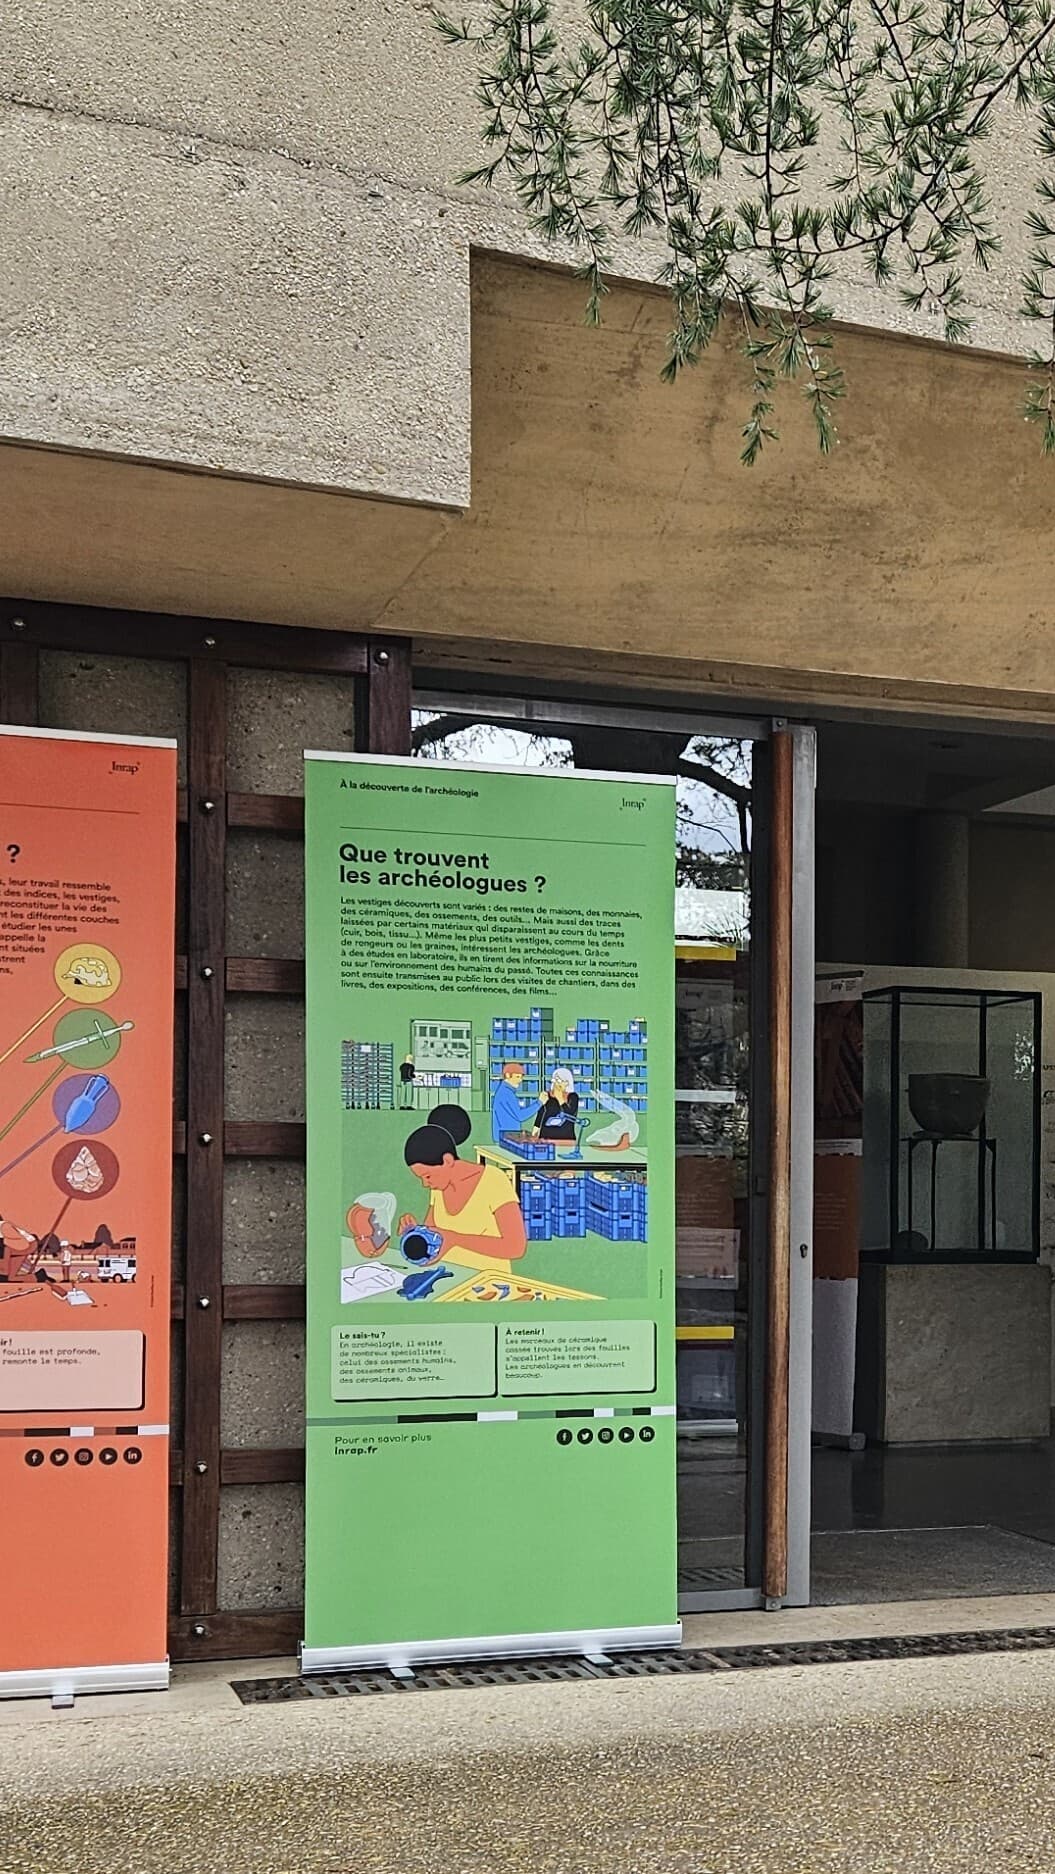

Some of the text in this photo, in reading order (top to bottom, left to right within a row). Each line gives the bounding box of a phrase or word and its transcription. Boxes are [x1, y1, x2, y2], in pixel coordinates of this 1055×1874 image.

[112, 761, 139, 774] Inrap
[340, 778, 479, 799] À la découverte de l'archéologie
[622, 798, 644, 810] Inrap
[7, 844, 20, 863] ?
[339, 842, 489, 868] Que trouvent
[8, 877, 28, 887] leur
[30, 878, 59, 888] travail
[62, 882, 111, 891] ressemble
[340, 864, 546, 894] les archéologues ?
[3, 888, 21, 897] des
[63, 891, 76, 900] les
[61, 902, 70, 911] la
[73, 903, 87, 912] vie
[90, 903, 107, 913] des
[341, 896, 356, 905] Les
[357, 898, 392, 908] vestiges
[394, 899, 440, 909] découverts
[443, 902, 461, 910] sont
[462, 903, 486, 911] variés
[493, 904, 508, 912] des
[510, 905, 534, 913] restes
[536, 906, 547, 914] de
[586, 908, 600, 916] des
[10, 910, 24, 919] les
[26, 911, 78, 922] différentes
[80, 915, 119, 924] couches
[1, 920, 36, 931] étudier
[38, 922, 52, 932] les
[340, 917, 375, 927] laissées
[377, 921, 392, 929] par
[394, 920, 429, 929] certains
[431, 922, 474, 931] matériaux
[475, 924, 489, 934] qui
[491, 924, 546, 935] disparaissent
[587, 928, 597, 937] du
[599, 929, 625, 940] temps
[37, 933, 46, 942] la
[11, 943, 45, 953] situées
[57, 1348, 100, 1356] profonde,
[54, 1358, 81, 1366] temps.
[334, 1436, 360, 1444] Pour
[378, 1434, 409, 1443] savoir
[411, 1434, 432, 1444] plus
[335, 1446, 378, 1456] inrap.fr
